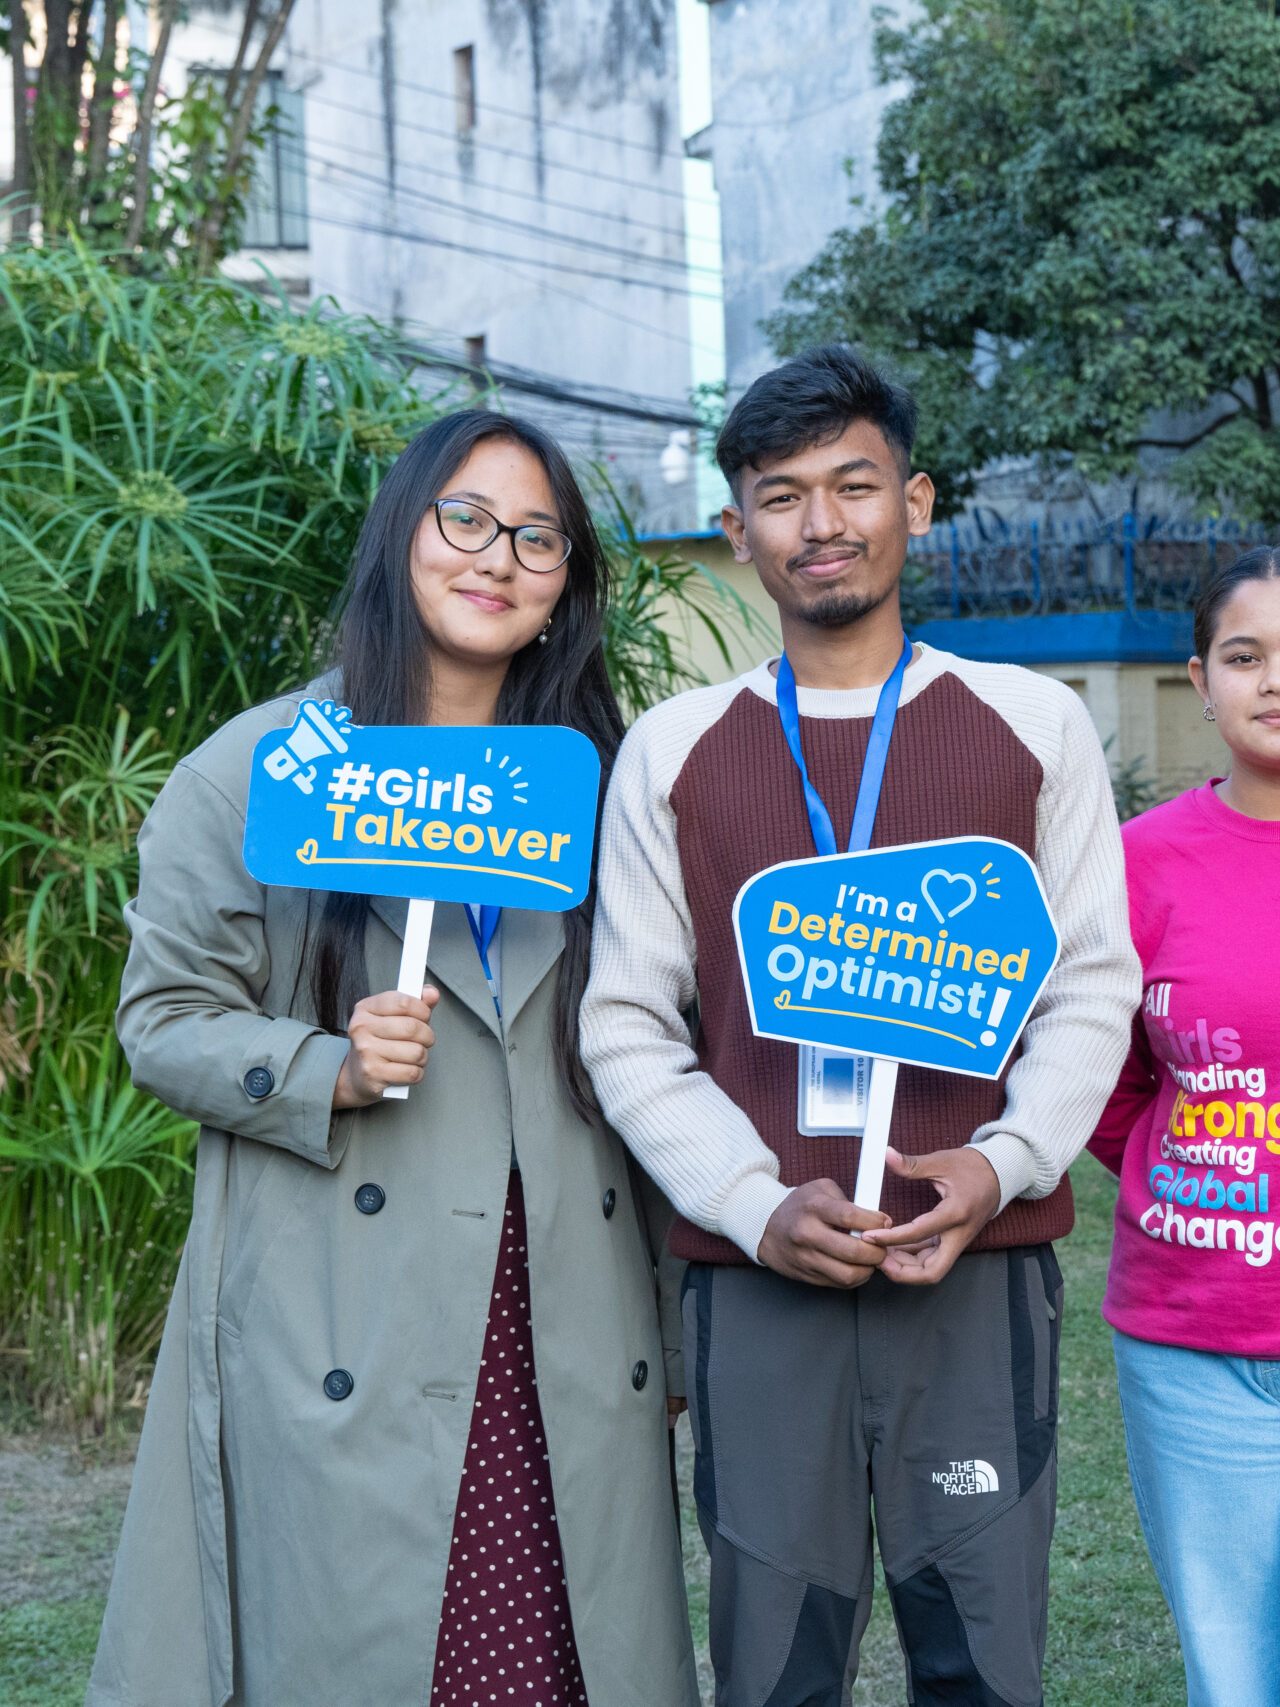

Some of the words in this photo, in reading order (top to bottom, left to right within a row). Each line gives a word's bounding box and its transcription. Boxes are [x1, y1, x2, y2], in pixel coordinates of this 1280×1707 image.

[328, 762, 494, 814] #Girls
[326, 803, 571, 862] Takeover
[836, 884, 887, 917] I'm
[896, 902, 917, 922] a
[768, 901, 1030, 982] Determined
[767, 944, 1012, 1047] Optimist!
[1145, 983, 1172, 1016] All
[858, 1057, 864, 1067] 10
[1160, 1134, 1257, 1175] Creating
[1150, 1164, 1269, 1213] Global
[932, 1472, 975, 1484] NORTH
[949, 1460, 974, 1472] THE
[944, 1483, 975, 1495] FACE
